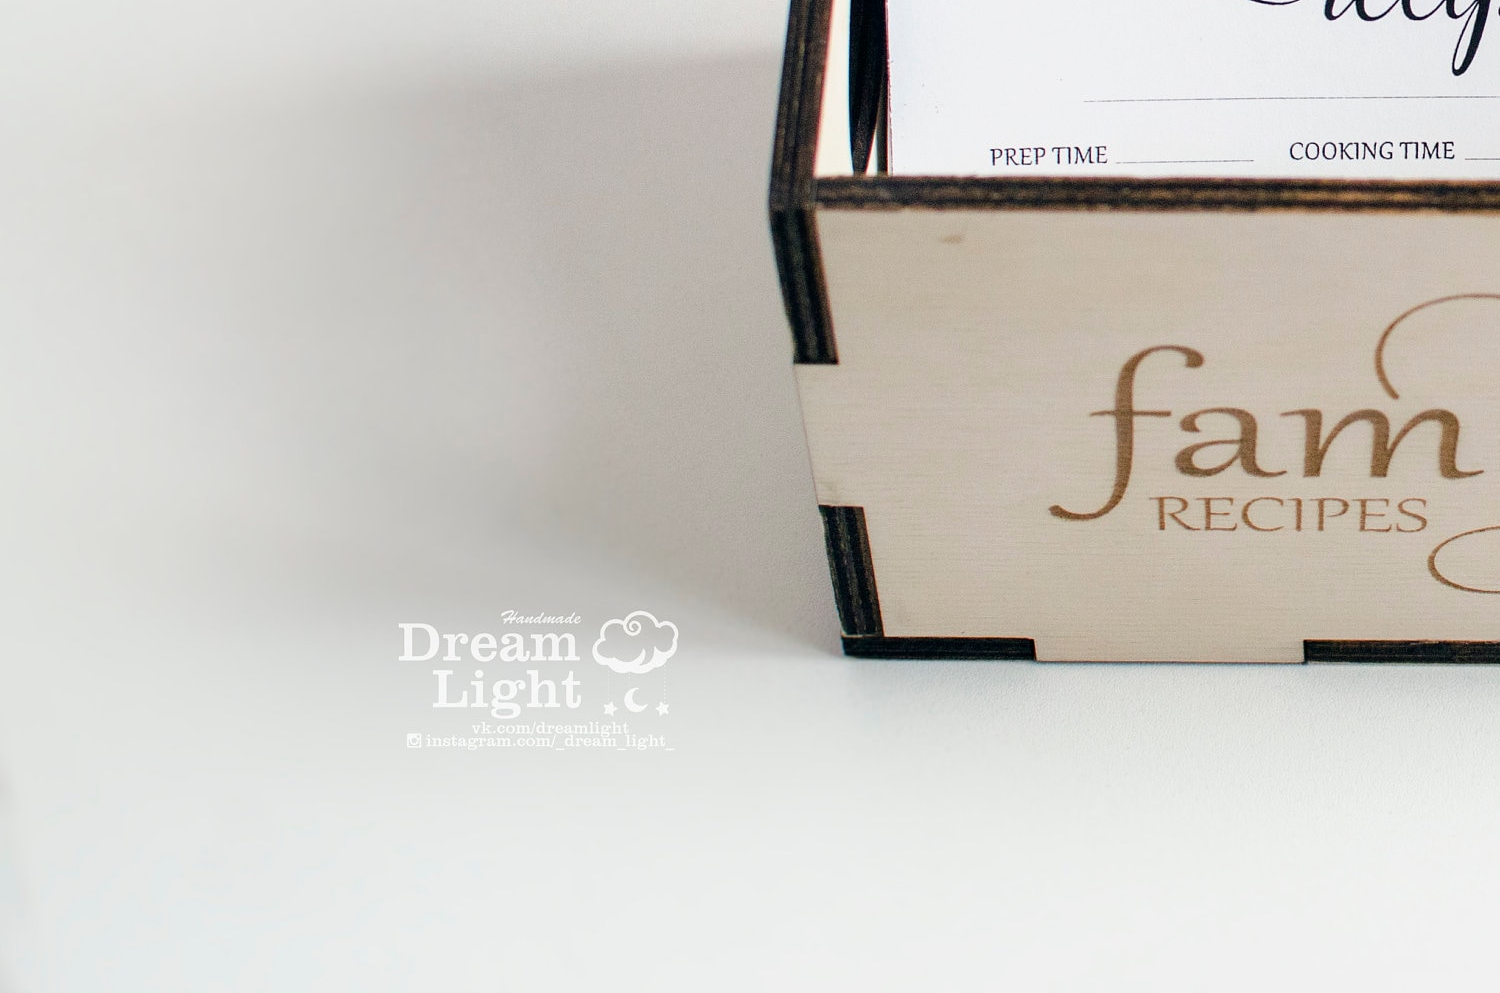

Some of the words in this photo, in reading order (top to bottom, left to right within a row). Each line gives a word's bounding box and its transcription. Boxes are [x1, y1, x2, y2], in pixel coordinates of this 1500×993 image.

[990, 147, 1046, 166] PREP
[1052, 145, 1108, 164] TIME
[1289, 141, 1394, 161] COOKING
[1399, 141, 1456, 160] TIME
[1149, 496, 1428, 533] RECIPES
